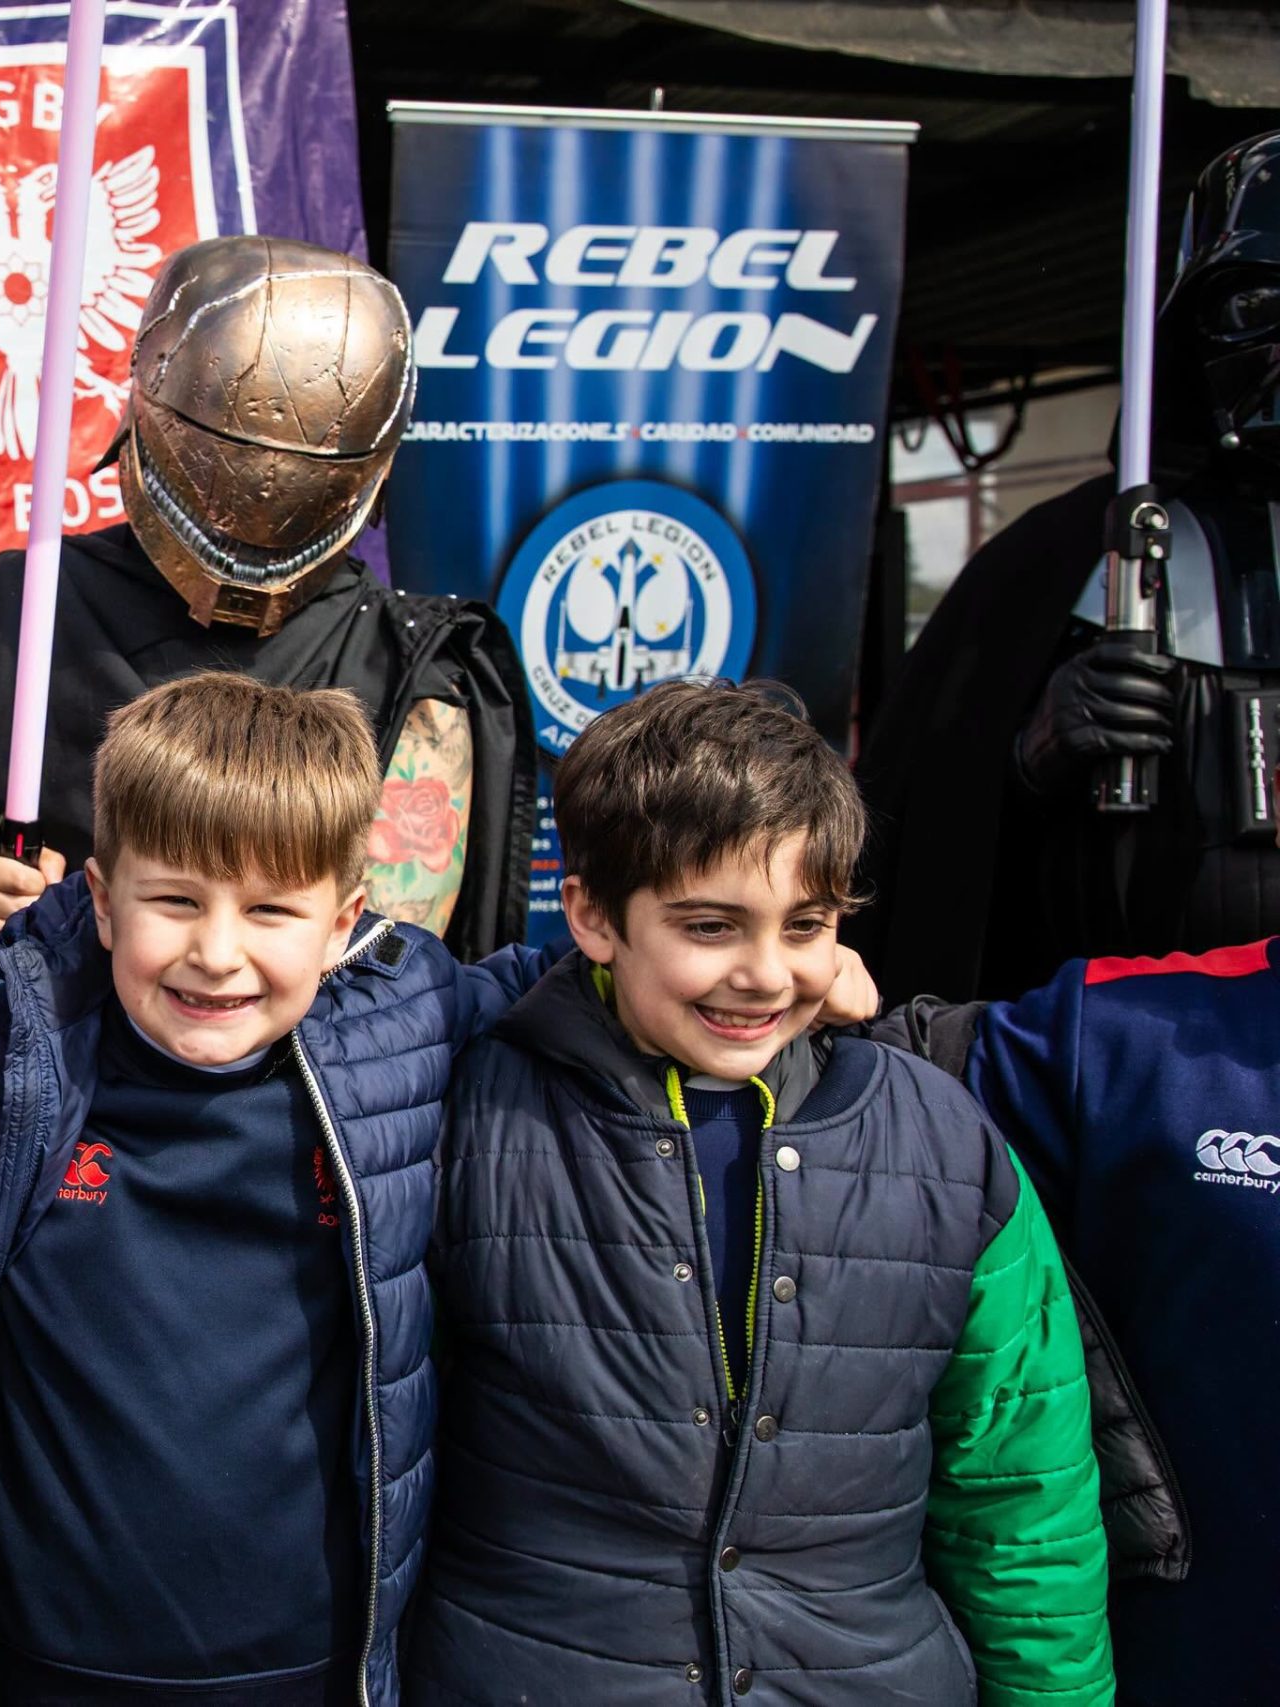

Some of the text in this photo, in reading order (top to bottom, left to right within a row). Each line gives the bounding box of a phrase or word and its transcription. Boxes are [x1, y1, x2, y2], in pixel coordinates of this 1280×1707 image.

[442, 221, 857, 291] REBEL
[414, 307, 878, 374] LEGION
[640, 421, 737, 442] CARIDAD
[747, 422, 875, 443] COMUNIDAD
[542, 516, 718, 584] REBEL LEGION
[56, 1186, 108, 1205] terbury
[1193, 1171, 1280, 1194] canterbury
